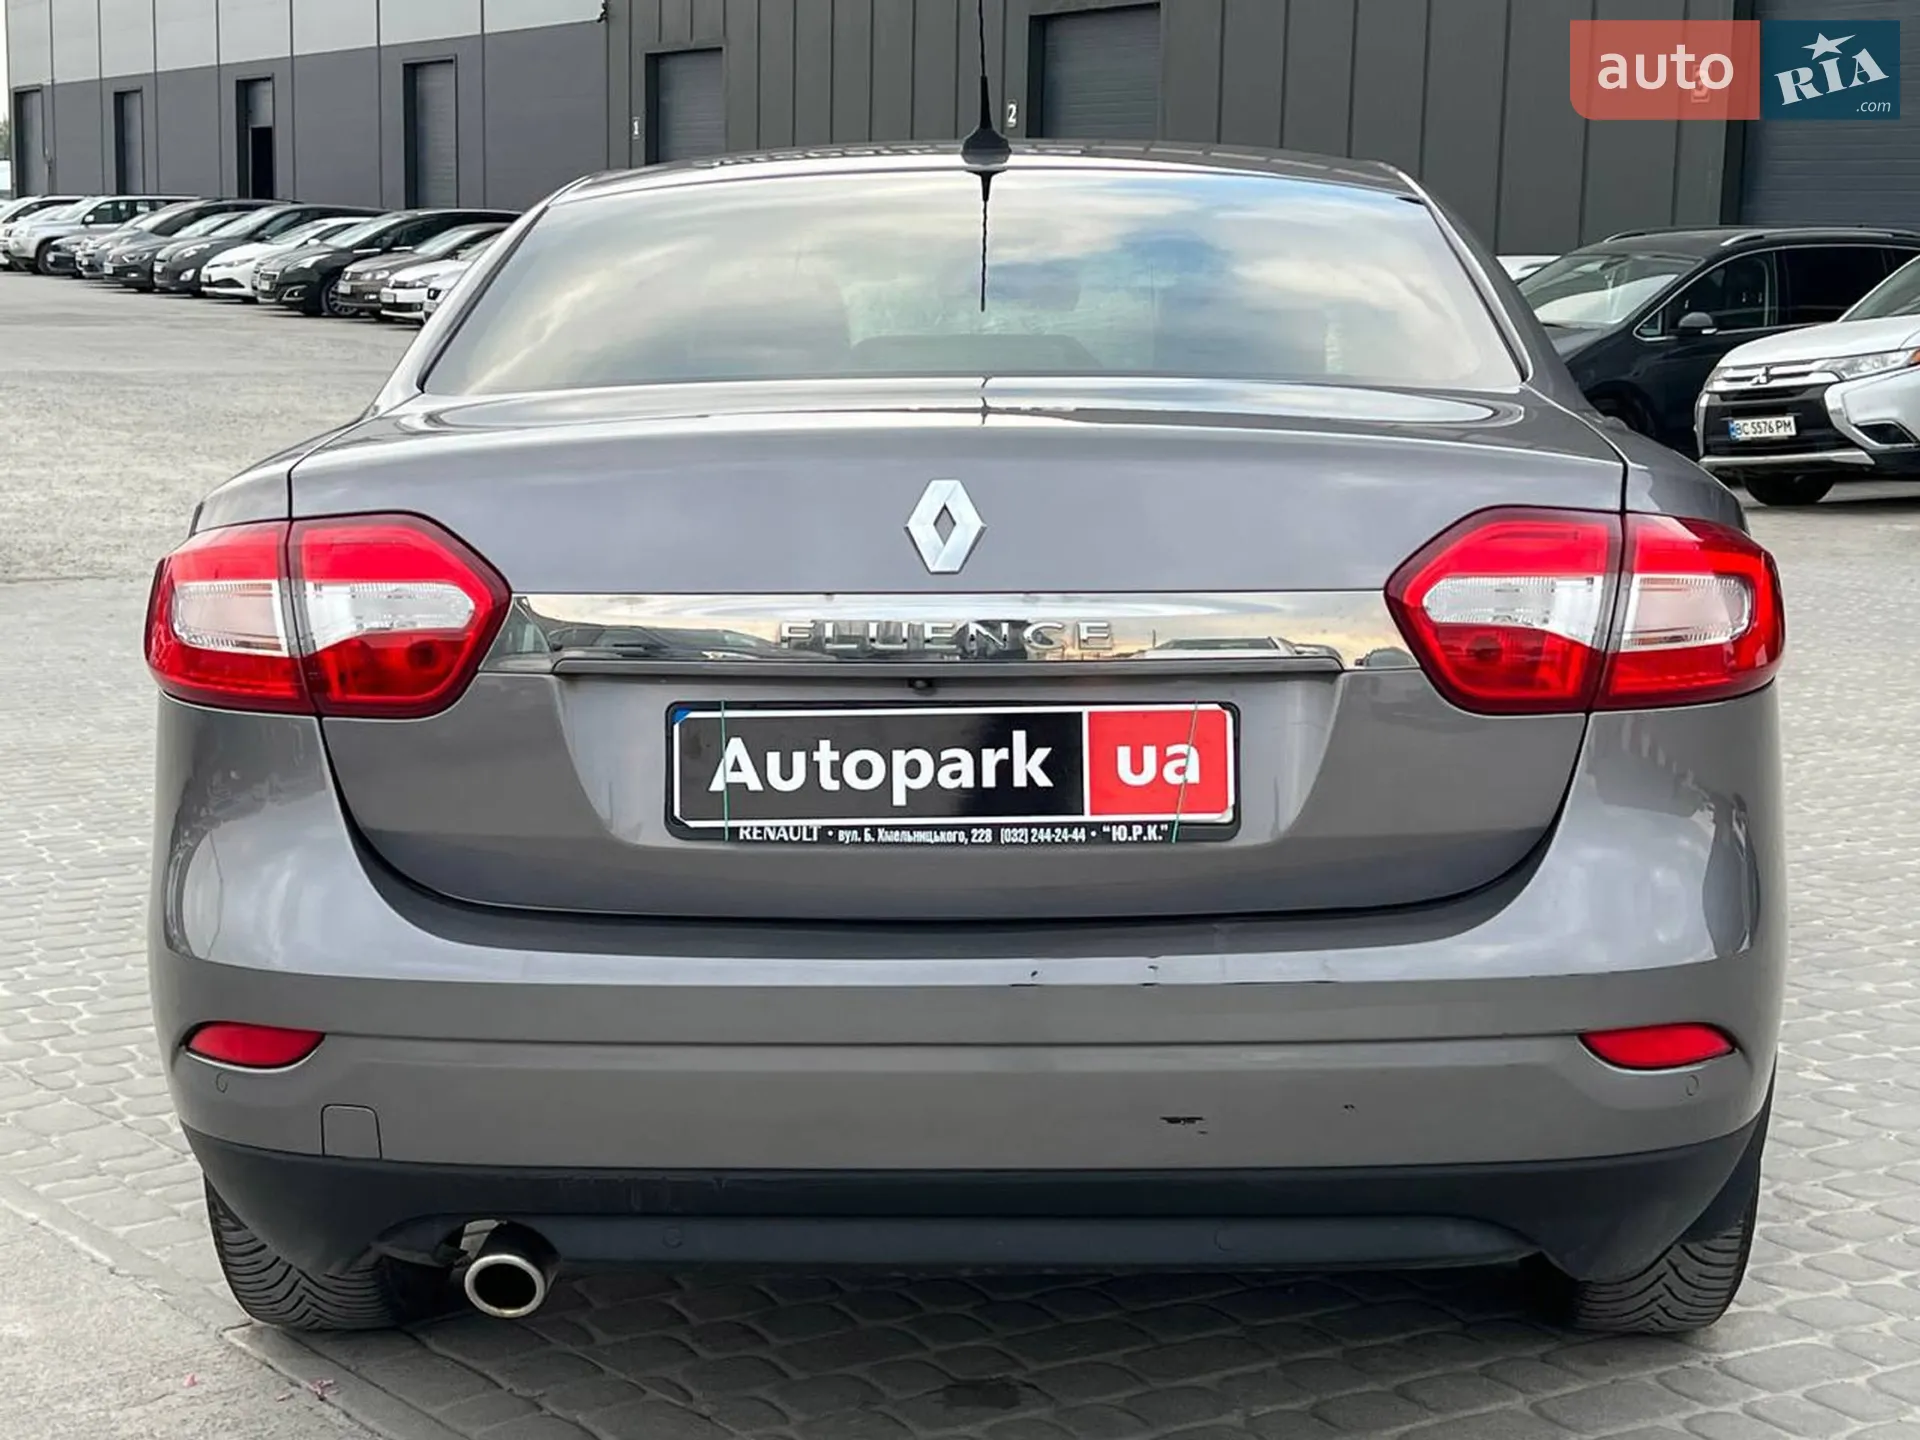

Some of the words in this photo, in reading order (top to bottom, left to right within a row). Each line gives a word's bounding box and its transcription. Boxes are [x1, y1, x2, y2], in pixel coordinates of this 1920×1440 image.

[1007, 103, 1017, 123] 2
[1751, 421, 1774, 434] 5576
[780, 620, 1113, 650] FLUENCE
[708, 730, 1054, 807] Autopark
[1116, 743, 1200, 786] ua
[739, 825, 820, 842] RENAULT
[838, 829, 861, 844] вул.
[864, 828, 875, 842] Б.
[971, 828, 992, 843] 228
[1001, 827, 1028, 844] (032)
[1031, 827, 1086, 843] 244-24-44
